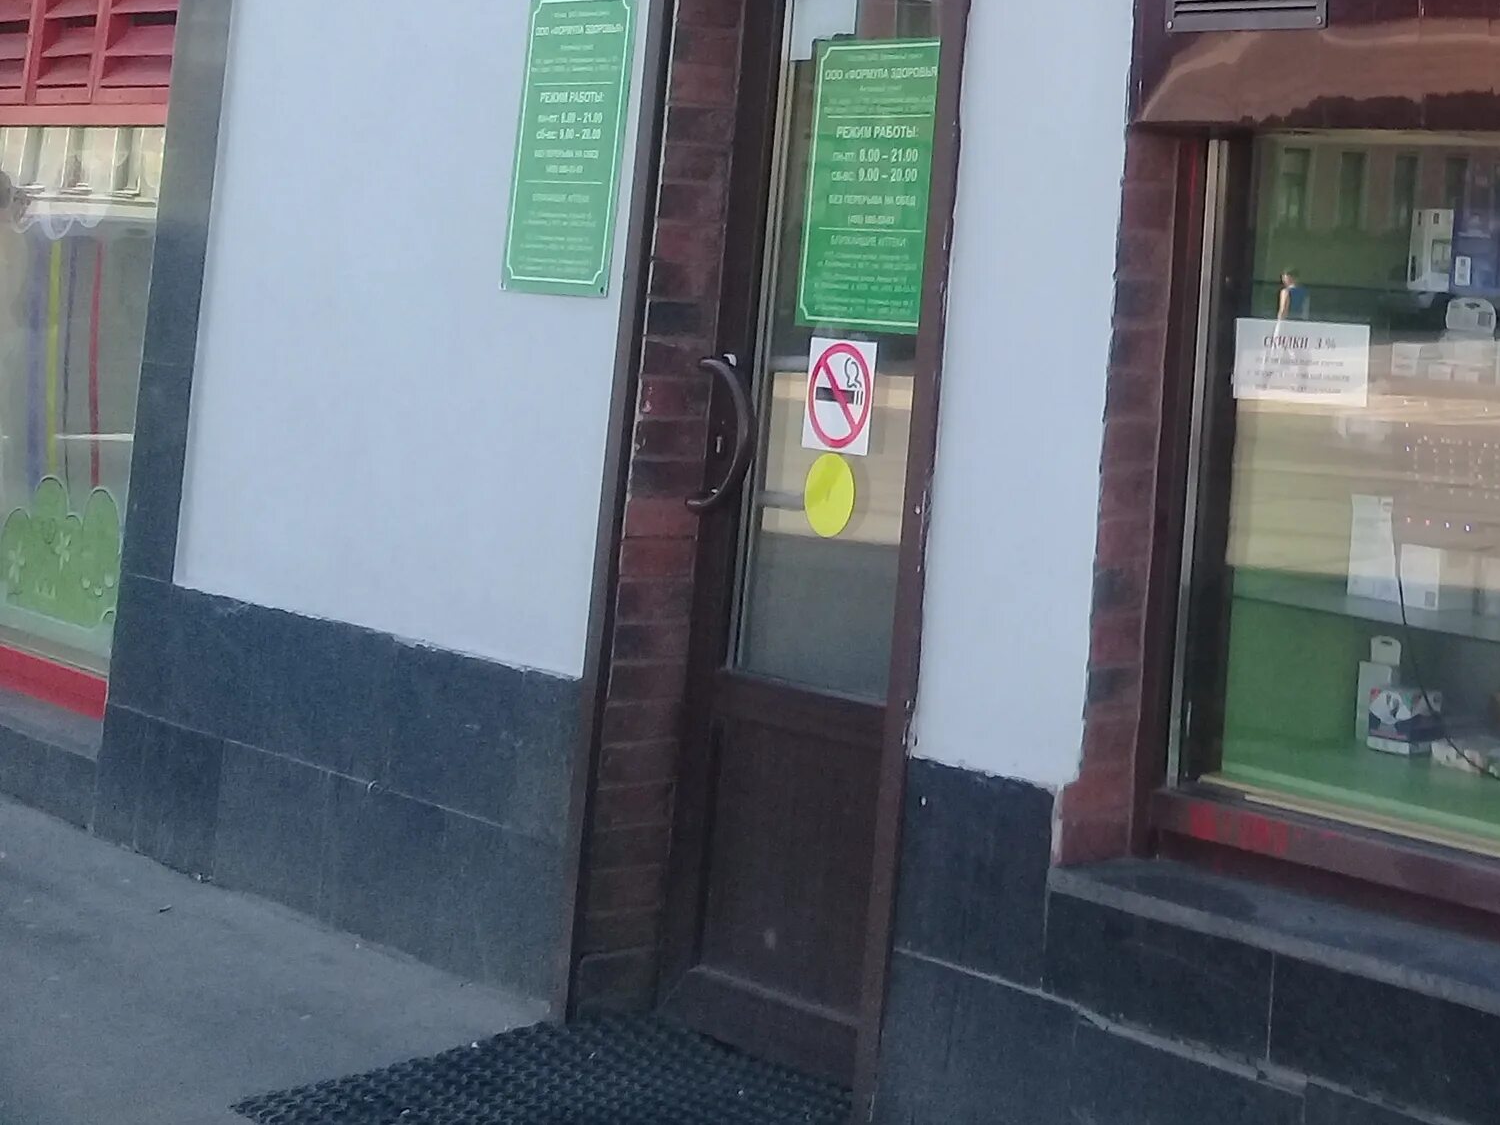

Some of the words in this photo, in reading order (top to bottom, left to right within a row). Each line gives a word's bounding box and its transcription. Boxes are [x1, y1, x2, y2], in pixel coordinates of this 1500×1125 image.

[540, 92, 568, 103] РЕЖИМ
[836, 126, 872, 139] РЕЖИМ
[873, 125, 919, 139] РАБОТЫ:
[859, 148, 880, 163] 8.00
[891, 148, 919, 163] 21.00
[858, 167, 880, 182] 9.00
[890, 167, 918, 183] 20.00
